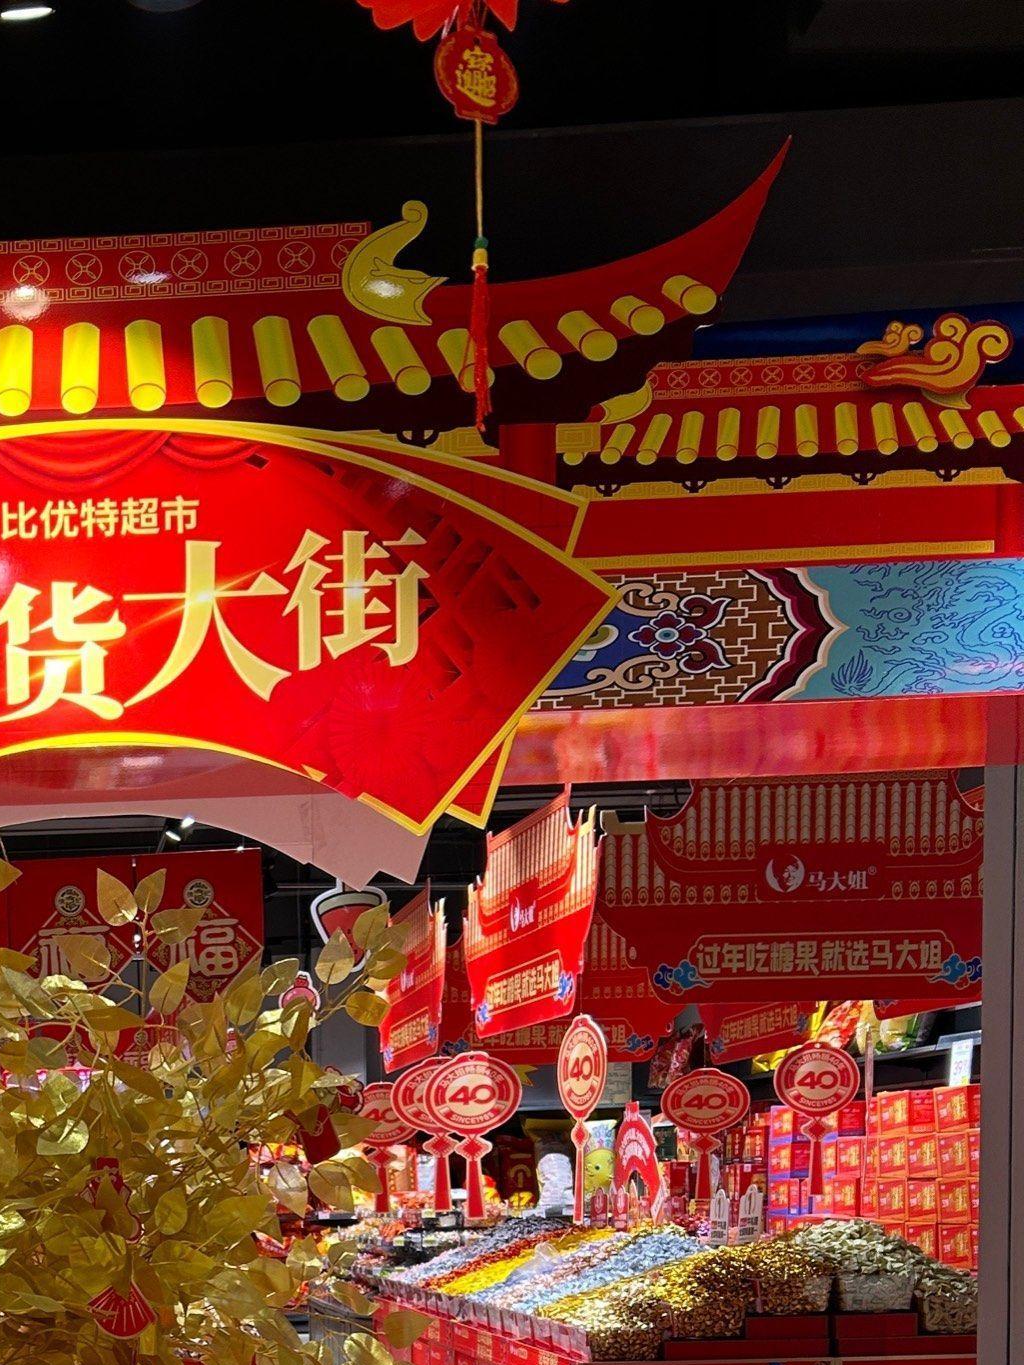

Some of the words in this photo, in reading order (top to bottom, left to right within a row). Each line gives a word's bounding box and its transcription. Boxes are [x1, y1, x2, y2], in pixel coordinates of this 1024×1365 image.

[0, 495, 199, 541] 比优特超市
[808, 869, 868, 892] 马大姐
[696, 939, 942, 976] 过年吃糖果就选马大姐
[486, 958, 559, 1011] 过年吃糖果就选马大姐
[570, 1055, 593, 1081] 40
[796, 1070, 838, 1089] 40
[448, 1085, 496, 1105] 40
[683, 1093, 728, 1110] 40
[364, 1108, 402, 1124] 40
